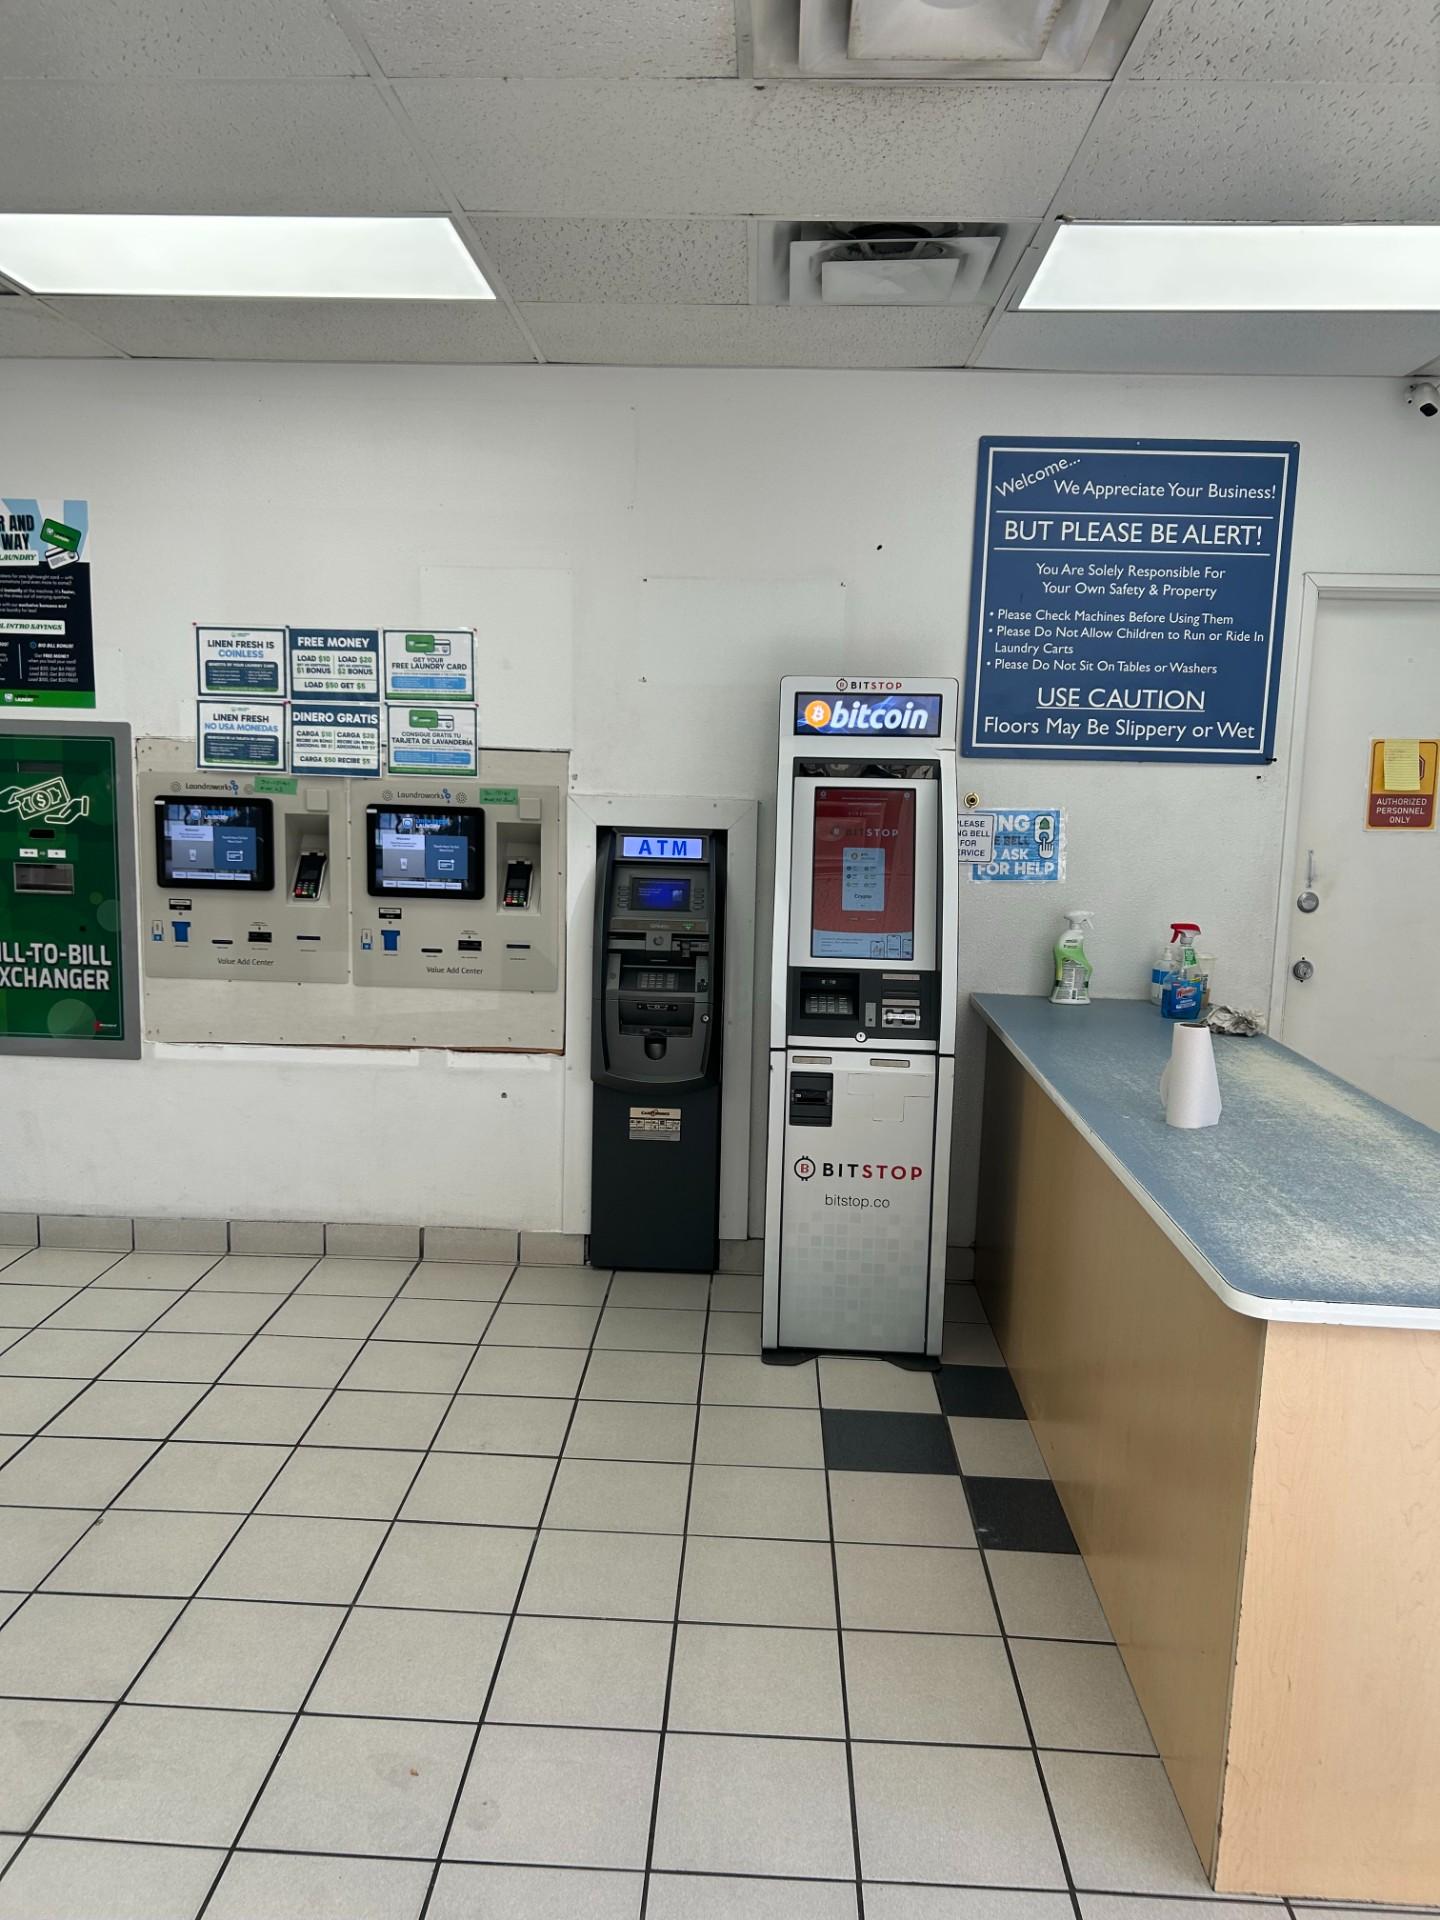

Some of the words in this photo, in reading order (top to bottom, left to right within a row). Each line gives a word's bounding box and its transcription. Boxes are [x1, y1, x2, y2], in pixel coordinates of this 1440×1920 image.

[995, 458, 1080, 496] Welcome...
[1054, 480, 1080, 495] We
[1083, 480, 1165, 499] Appreciate
[1168, 482, 1203, 497] Your
[1208, 483, 1276, 499] Business!
[9, 515, 34, 532] AND
[1005, 520, 1054, 541] BUT
[1061, 521, 1143, 542] PLEASE
[1150, 523, 1178, 543] BE
[1182, 524, 1262, 546] ALERT!
[1, 534, 29, 550] WAY
[1036, 562, 1058, 575] You
[1061, 563, 1084, 576] Are
[1088, 564, 1124, 580] Solely
[1128, 565, 1200, 580] Responsible
[1204, 566, 1226, 579] For
[1042, 581, 1071, 594] Your
[1075, 582, 1105, 595] Own
[1109, 583, 1146, 598] Safety
[1149, 584, 1158, 596] &
[1163, 584, 1217, 600] Property
[997, 608, 1032, 620] Please
[1035, 609, 1071, 621] Check
[1074, 610, 1125, 622] Machines
[1129, 611, 1166, 623] Before
[1169, 612, 1200, 627] Using
[1202, 613, 1234, 625] Them
[997, 625, 1031, 637] Please
[1034, 626, 1052, 637] Do
[1056, 627, 1078, 638] Not
[1080, 627, 1113, 638] Allow
[1116, 628, 1164, 639] Children
[1168, 631, 1180, 640] to
[1183, 630, 1206, 641] Run
[1209, 632, 1222, 641] or
[1226, 630, 1250, 642] Ride
[1254, 631, 1264, 642] In
[207, 639, 233, 648] LINEN
[235, 640, 264, 649] FRESH
[266, 641, 275, 649] IS
[297, 636, 324, 647] FREE
[327, 637, 370, 649] MONEY
[995, 642, 1039, 656] Laundry
[1043, 643, 1074, 654] Carts
[218, 649, 264, 658] COINLESS
[446, 663, 468, 671] CARD
[994, 659, 1029, 670] Please
[1032, 660, 1050, 670] Do
[1053, 660, 1076, 671] Not
[1080, 660, 1094, 671] Sit
[1097, 661, 1115, 671] On
[1117, 661, 1151, 672] Tables
[1154, 664, 1167, 673] or
[1169, 662, 1218, 674] Washers
[304, 681, 324, 689] LOAD
[851, 681, 902, 690] BITSTOP
[1037, 687, 1081, 707] USE
[1088, 688, 1205, 710] CAUTION
[213, 713, 239, 722] LINEN
[240, 714, 270, 723] FRESH
[292, 711, 335, 723] DINERO
[336, 713, 379, 725] GRATIS
[831, 701, 928, 729] bitcoin
[204, 722, 217, 730] NO
[219, 723, 235, 731] USA
[237, 723, 279, 732] MONEDAS
[984, 716, 1039, 733] Floors
[1046, 717, 1081, 739] May
[1087, 718, 1109, 735] Be
[1115, 719, 1186, 742] Slippery
[1192, 726, 1213, 737] or
[1217, 721, 1255, 738] Wet
[1376, 798, 1428, 806] AUTHORIZED
[1376, 807, 1425, 815] PERSONNEL
[957, 820, 985, 828] LEASE
[1389, 816, 1411, 824] ONLY
[969, 830, 990, 838] BELL
[638, 839, 688, 857] ATM
[960, 839, 977, 847] FOR
[1001, 849, 1029, 860] ASK
[977, 861, 1010, 875] FOR
[1014, 862, 1055, 875] HELP
[0, 942, 112, 966] LL-TO-BILL
[217, 957, 235, 965] Value
[252, 958, 274, 966] Center
[426, 966, 445, 974] Value
[446, 966, 459, 974] Add
[461, 967, 483, 975] Center
[822, 1163, 922, 1181] BITSTOP
[825, 1193, 890, 1209] bitstop.co
